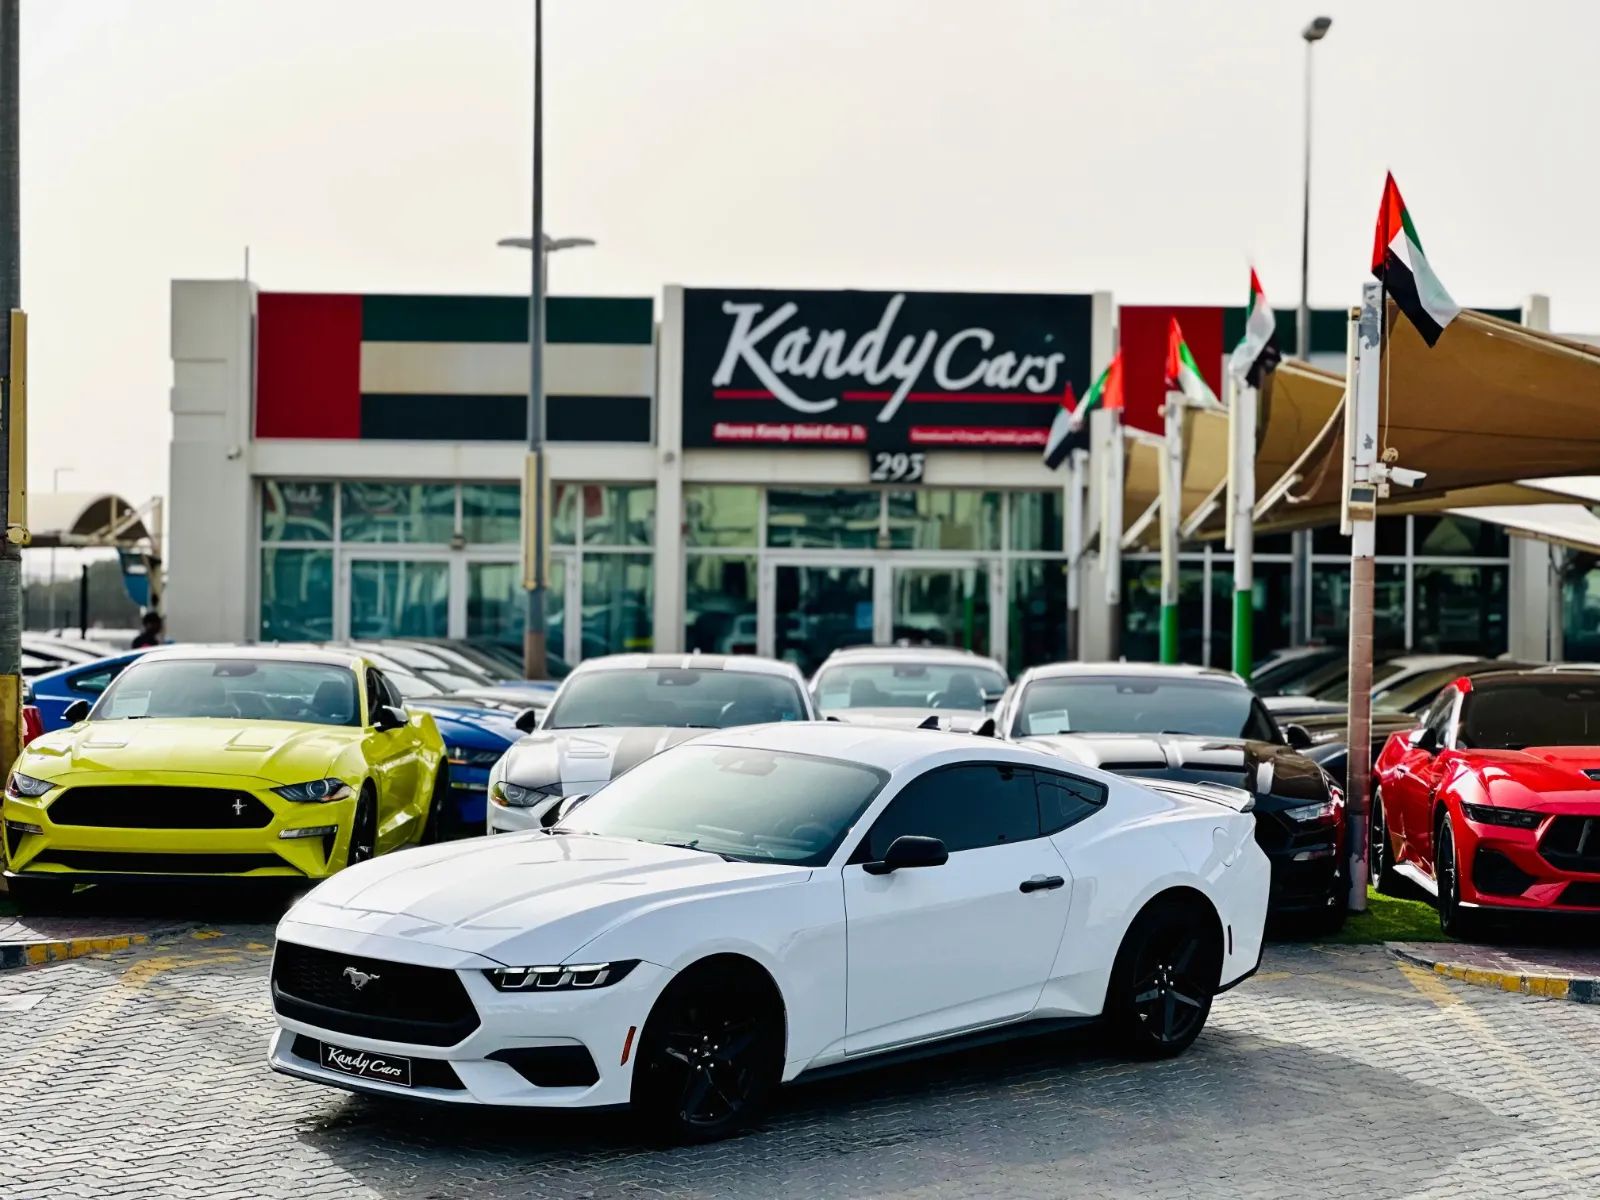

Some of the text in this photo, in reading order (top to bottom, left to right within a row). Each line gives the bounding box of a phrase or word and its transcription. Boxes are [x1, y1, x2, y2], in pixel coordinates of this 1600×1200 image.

[712, 293, 1065, 422] Kandy Cars
[328, 1047, 402, 1076] Kandy Cars
